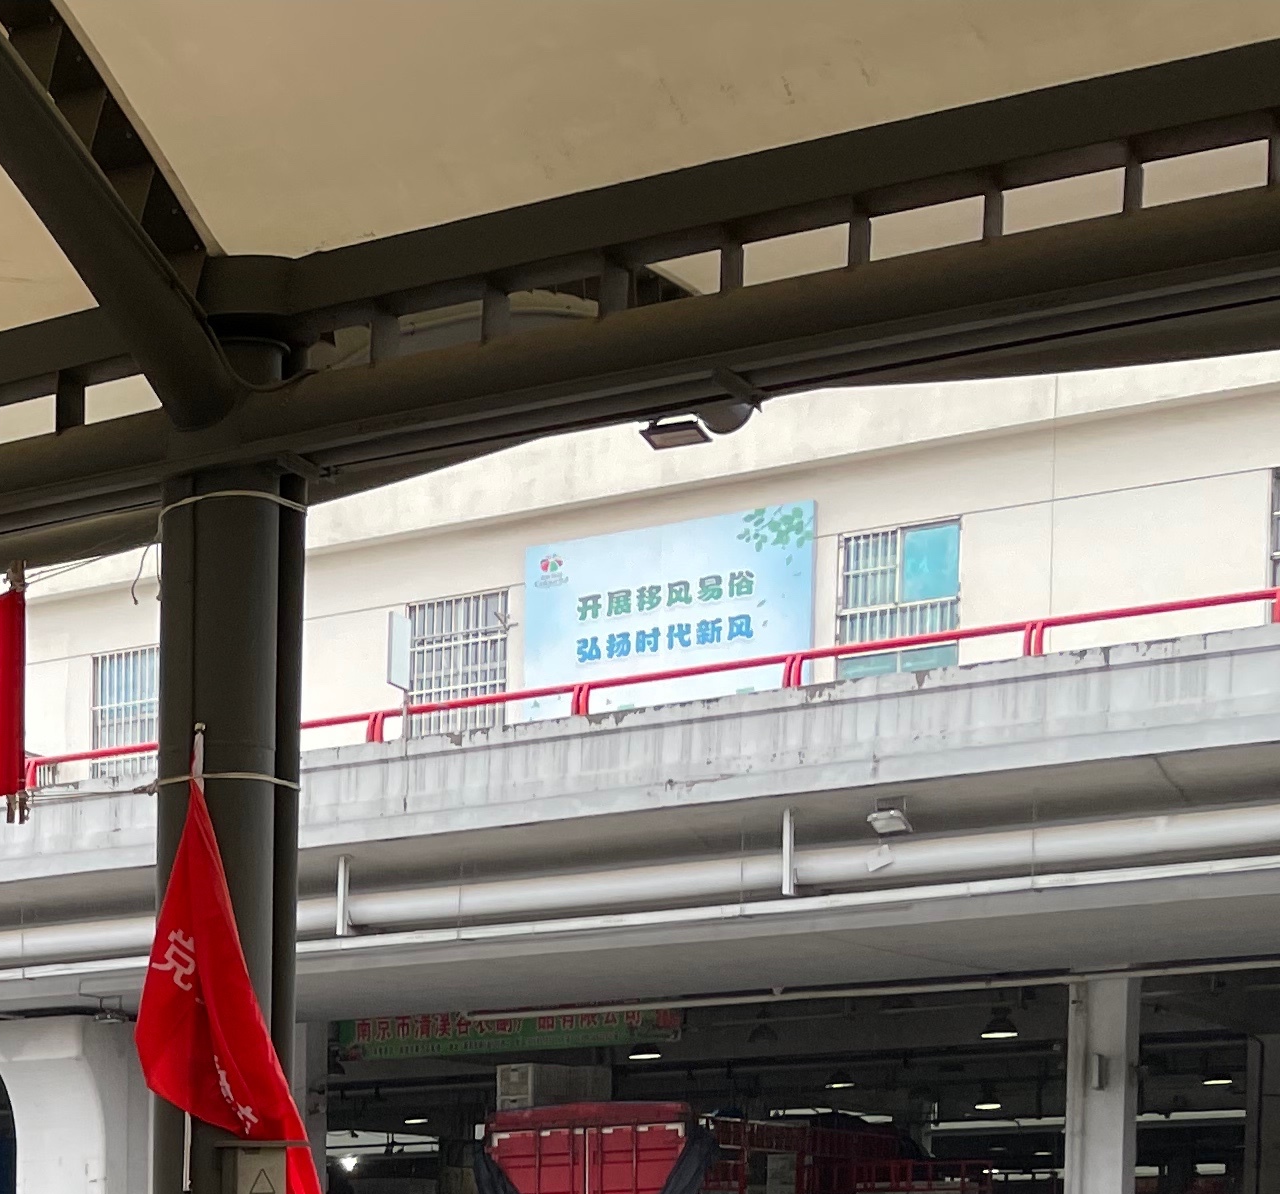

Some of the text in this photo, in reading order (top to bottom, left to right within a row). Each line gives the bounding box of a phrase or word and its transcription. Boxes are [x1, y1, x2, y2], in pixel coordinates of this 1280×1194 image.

[577, 570, 755, 621] 开展移风易俗
[576, 614, 754, 663] 弘扬时代新风
